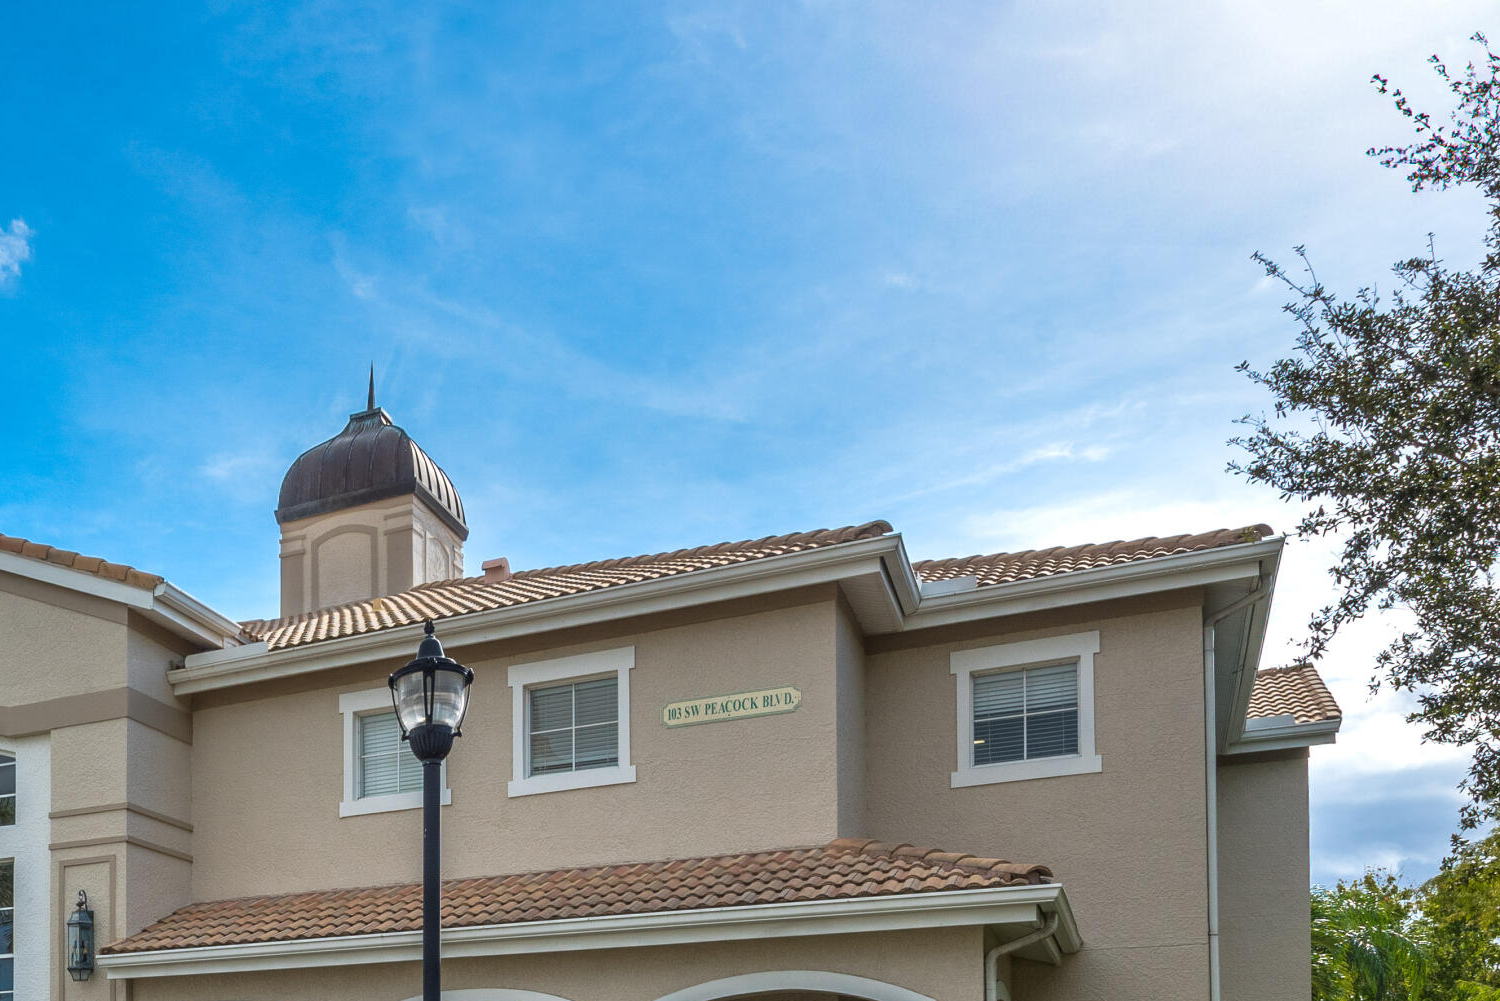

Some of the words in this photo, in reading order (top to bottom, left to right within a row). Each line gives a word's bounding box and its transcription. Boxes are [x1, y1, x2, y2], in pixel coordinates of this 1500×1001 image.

[667, 707, 682, 721] 103
[684, 704, 701, 719] SW
[704, 697, 759, 716] PEACOCK
